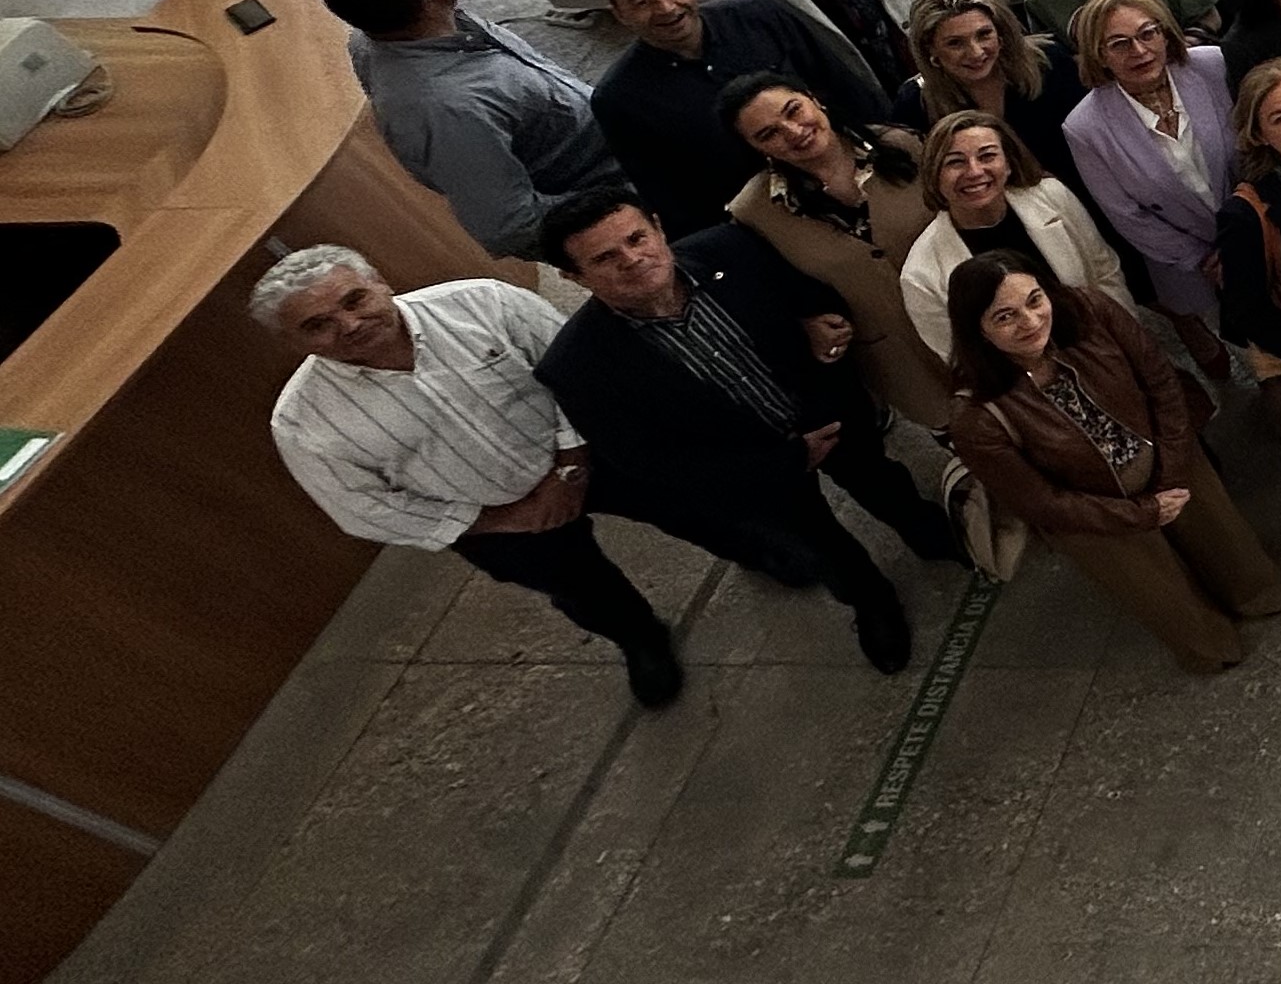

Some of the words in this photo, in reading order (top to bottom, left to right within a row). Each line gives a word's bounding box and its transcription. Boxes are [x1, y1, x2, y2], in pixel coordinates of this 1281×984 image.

[875, 714, 934, 809] RESPETE
[918, 618, 980, 718] DISTANCIA
[964, 591, 993, 616] DE
